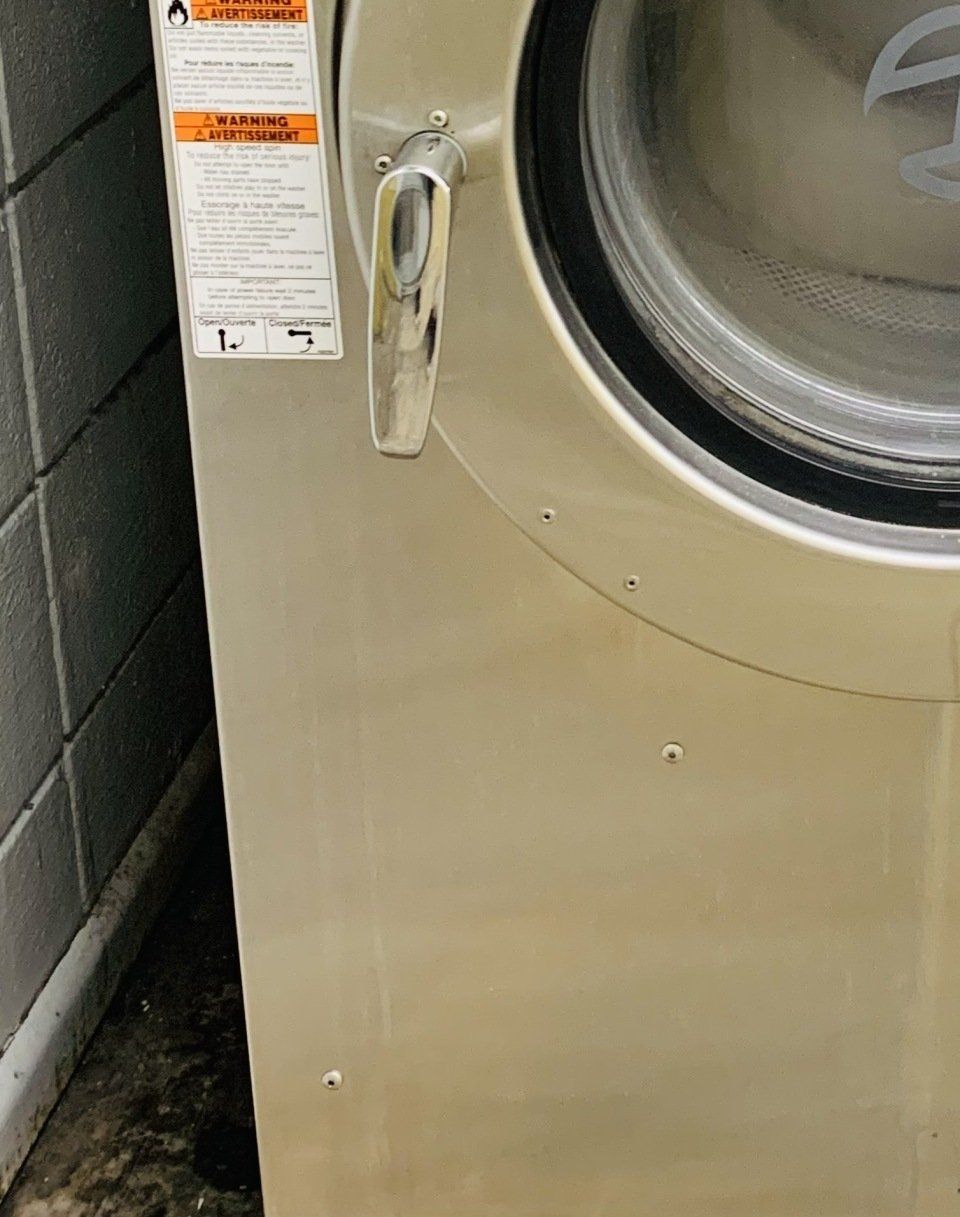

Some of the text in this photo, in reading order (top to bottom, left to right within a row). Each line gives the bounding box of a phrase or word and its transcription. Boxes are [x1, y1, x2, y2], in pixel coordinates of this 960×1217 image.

[211, 8, 303, 21] AVERTISSEMENT
[215, 115, 288, 128] WARNING
[208, 130, 300, 142] AVERTISSEMENT
[198, 318, 256, 327] Open/Ouverte
